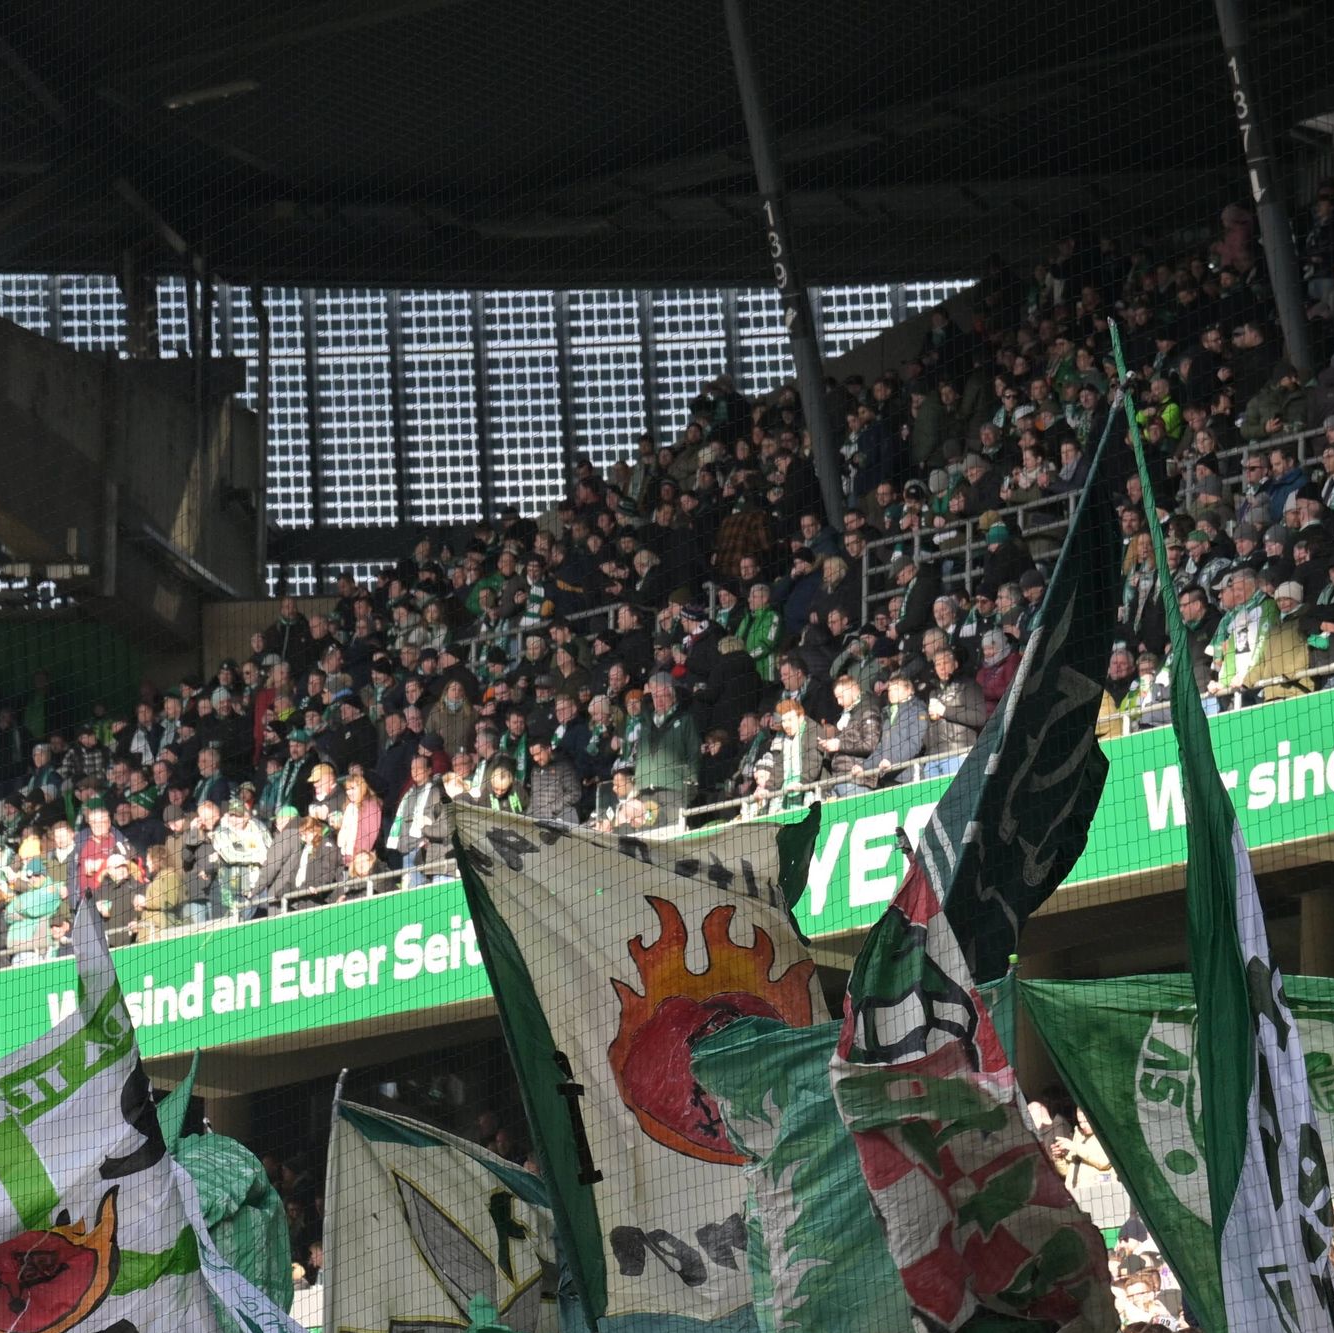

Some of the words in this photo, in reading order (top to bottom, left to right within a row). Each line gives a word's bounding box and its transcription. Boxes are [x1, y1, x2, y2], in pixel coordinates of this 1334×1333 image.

[1227, 55, 1249, 153] 137
[213, 967, 271, 1010] an
[271, 938, 386, 1001] Eurer
[392, 918, 481, 980] Seit
